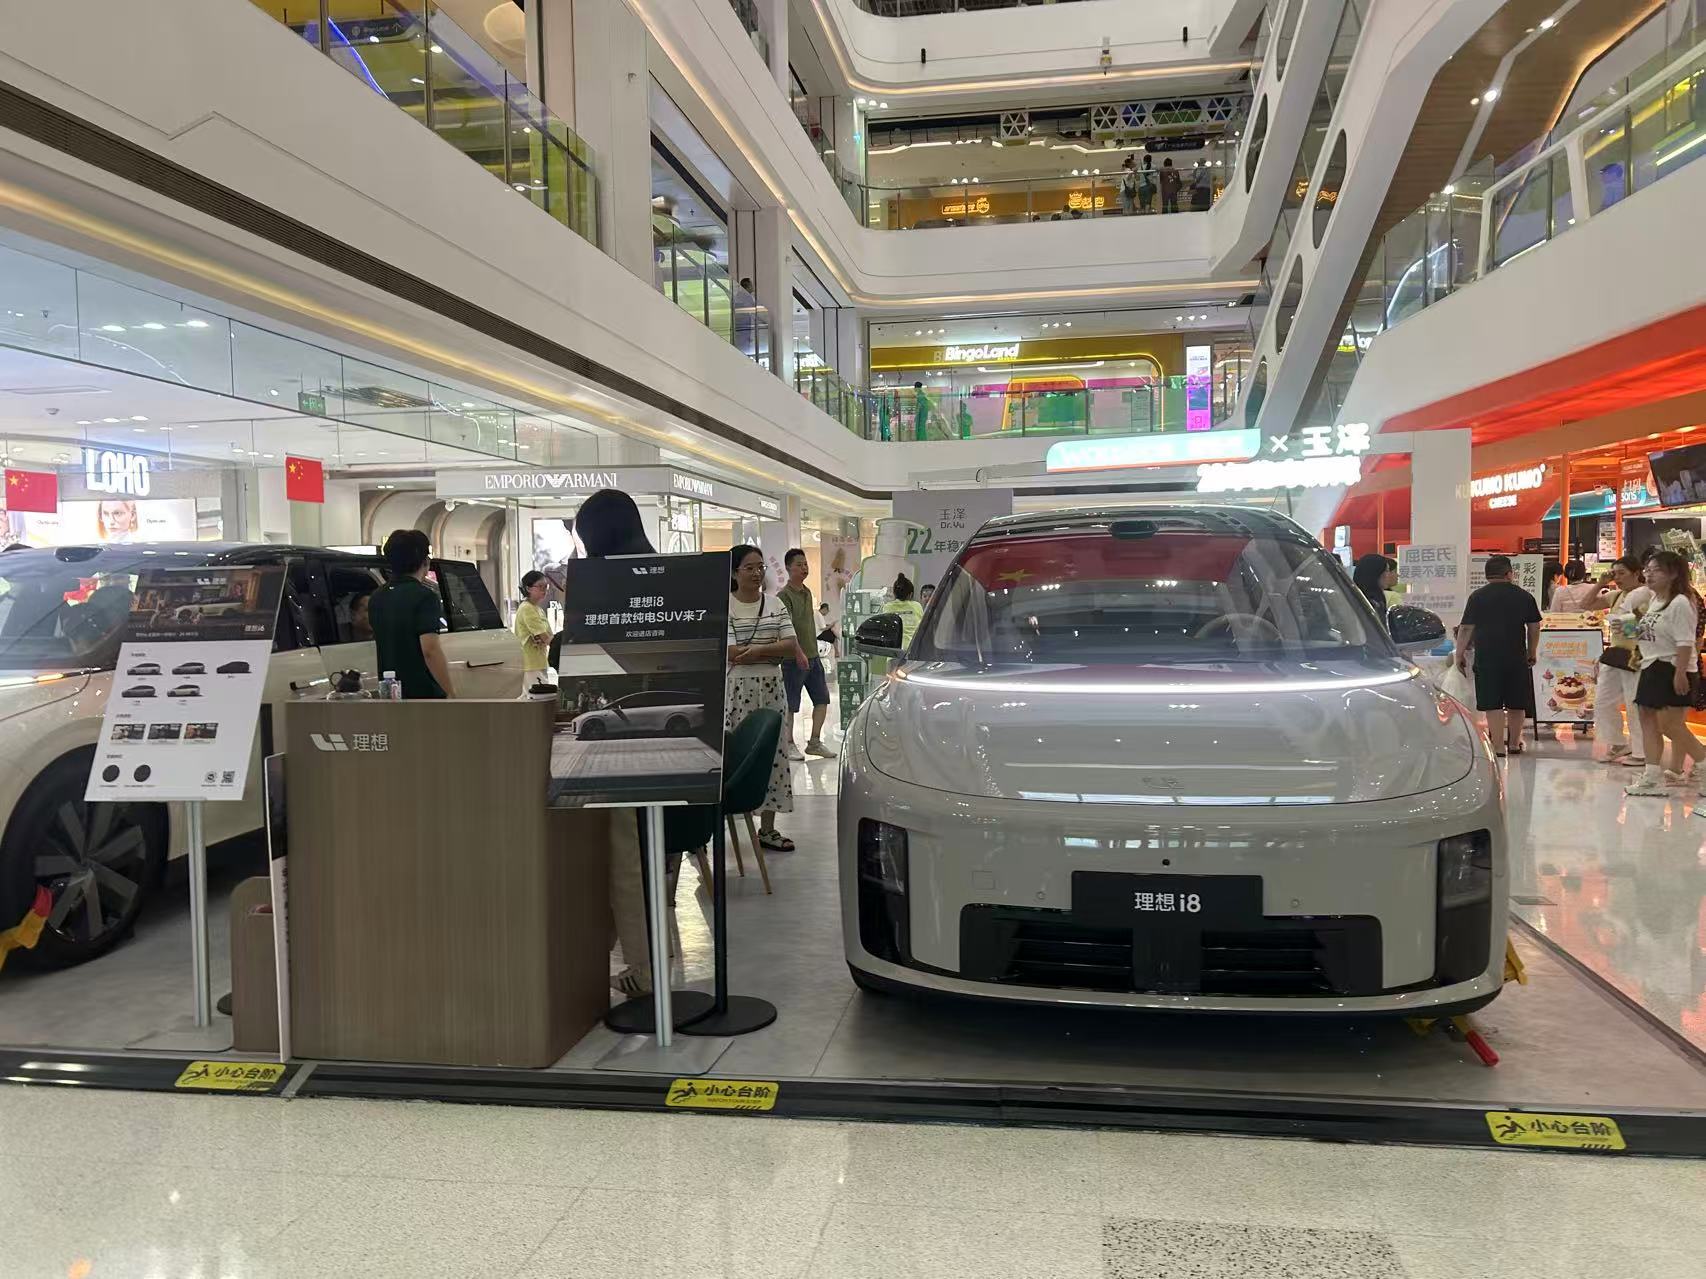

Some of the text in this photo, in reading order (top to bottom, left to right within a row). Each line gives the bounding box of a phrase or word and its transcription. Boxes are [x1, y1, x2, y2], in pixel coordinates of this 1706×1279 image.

[945, 343, 1020, 361] BingoLand
[1302, 423, 1370, 455] 玉泽
[86, 448, 150, 496] LOHO
[485, 473, 618, 490] EMPORIO ARMANI
[939, 508, 967, 521] 玉泽
[1405, 547, 1452, 564] 屈臣氏
[629, 596, 664, 609] 理想i8
[584, 609, 707, 626] 理想首款纯电SUV来了
[352, 733, 389, 751] 理想
[1134, 892, 1201, 913] 理想 i8
[214, 1066, 277, 1080] 小心台阶
[704, 1084, 771, 1098] 小心台阶
[1530, 1119, 1612, 1136] 小心台阶
